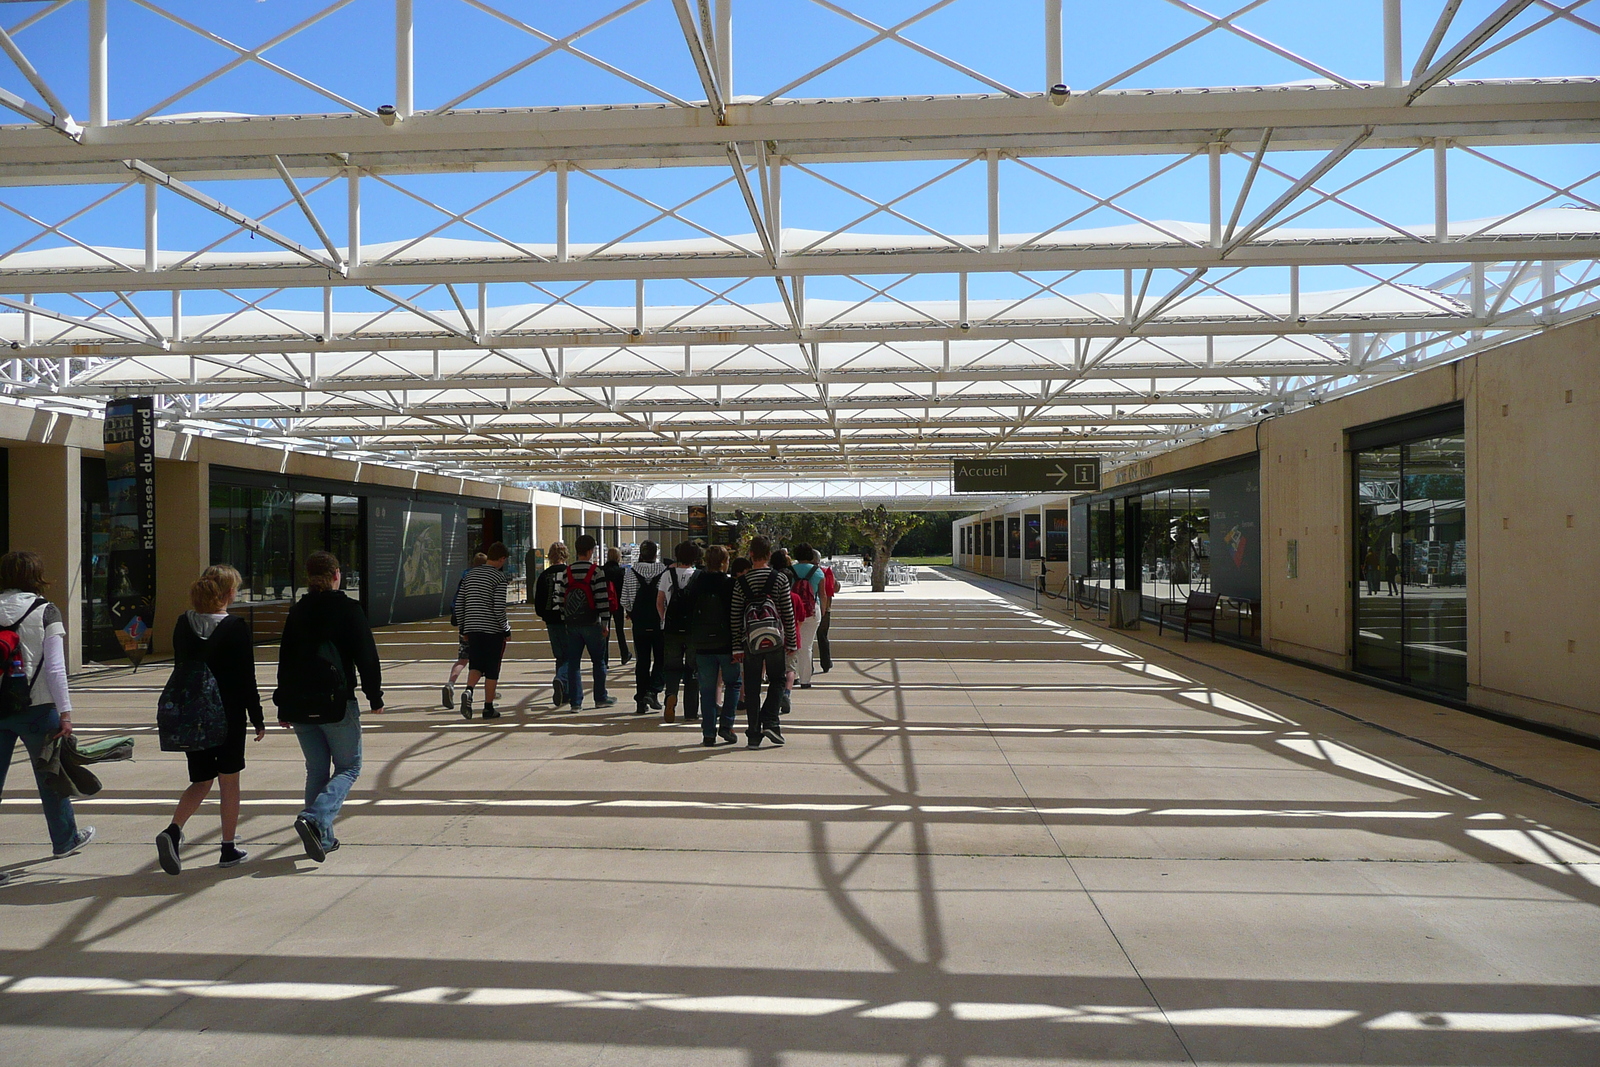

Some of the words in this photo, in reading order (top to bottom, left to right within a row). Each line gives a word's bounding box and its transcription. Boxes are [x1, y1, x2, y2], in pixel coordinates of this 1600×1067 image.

[137, 408, 152, 449] Gard
[140, 453, 153, 473] du
[958, 464, 1007, 476] Accueil
[143, 478, 154, 549] Richesses
